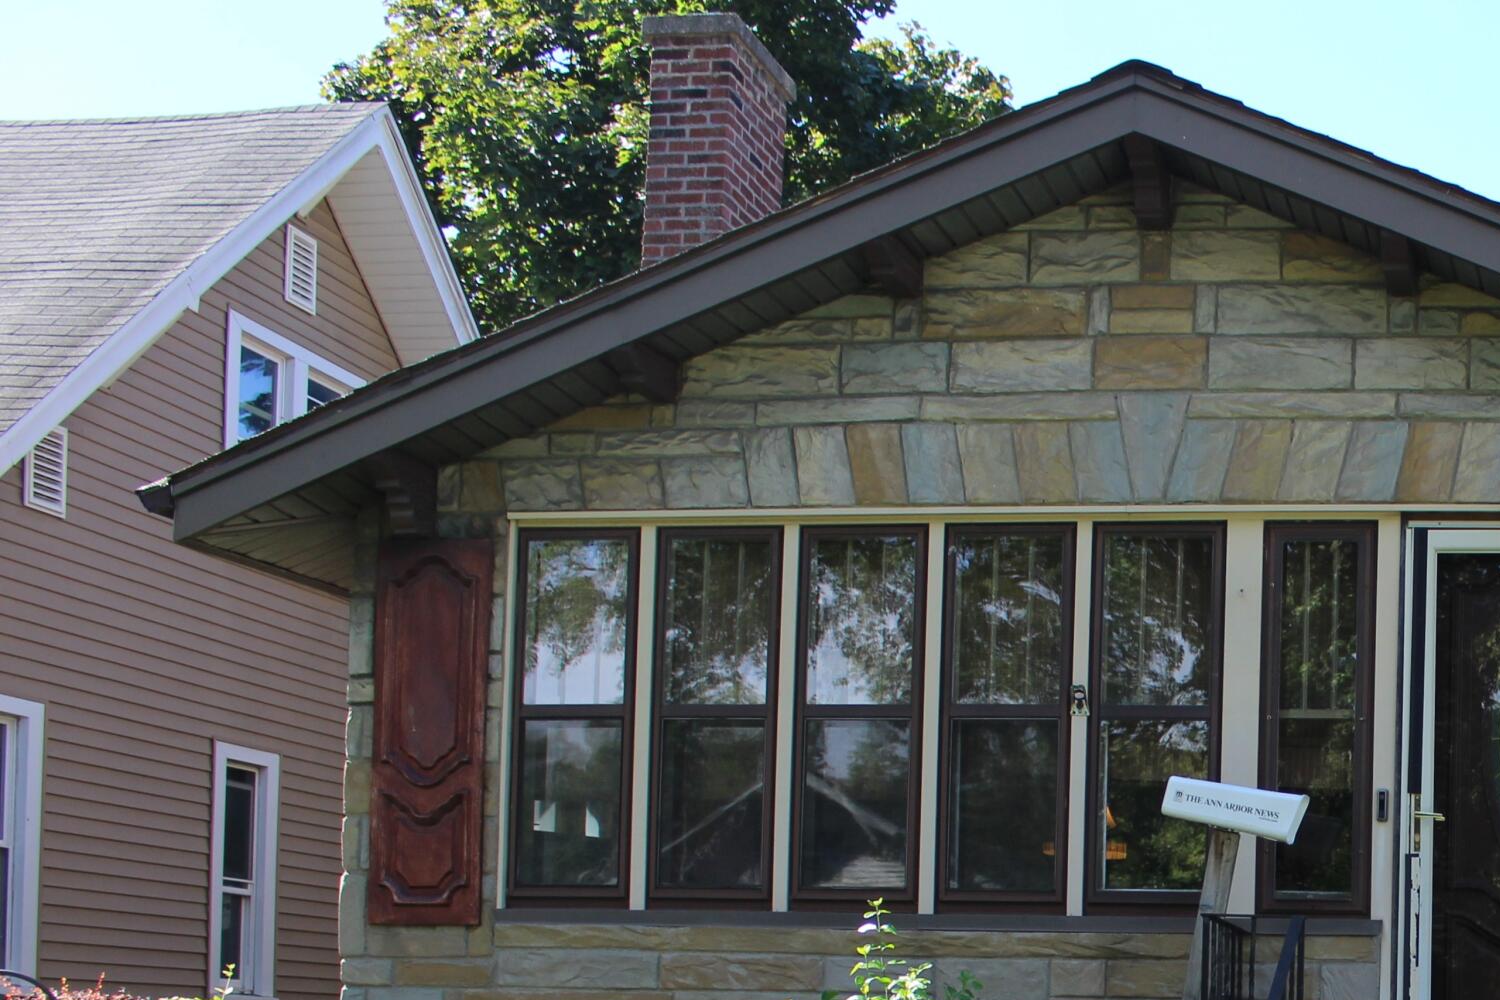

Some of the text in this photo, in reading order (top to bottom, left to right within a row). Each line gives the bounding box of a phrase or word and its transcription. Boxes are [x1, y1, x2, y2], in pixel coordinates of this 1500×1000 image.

[1185, 793, 1280, 819] THE ANN ARBOR NEWS
